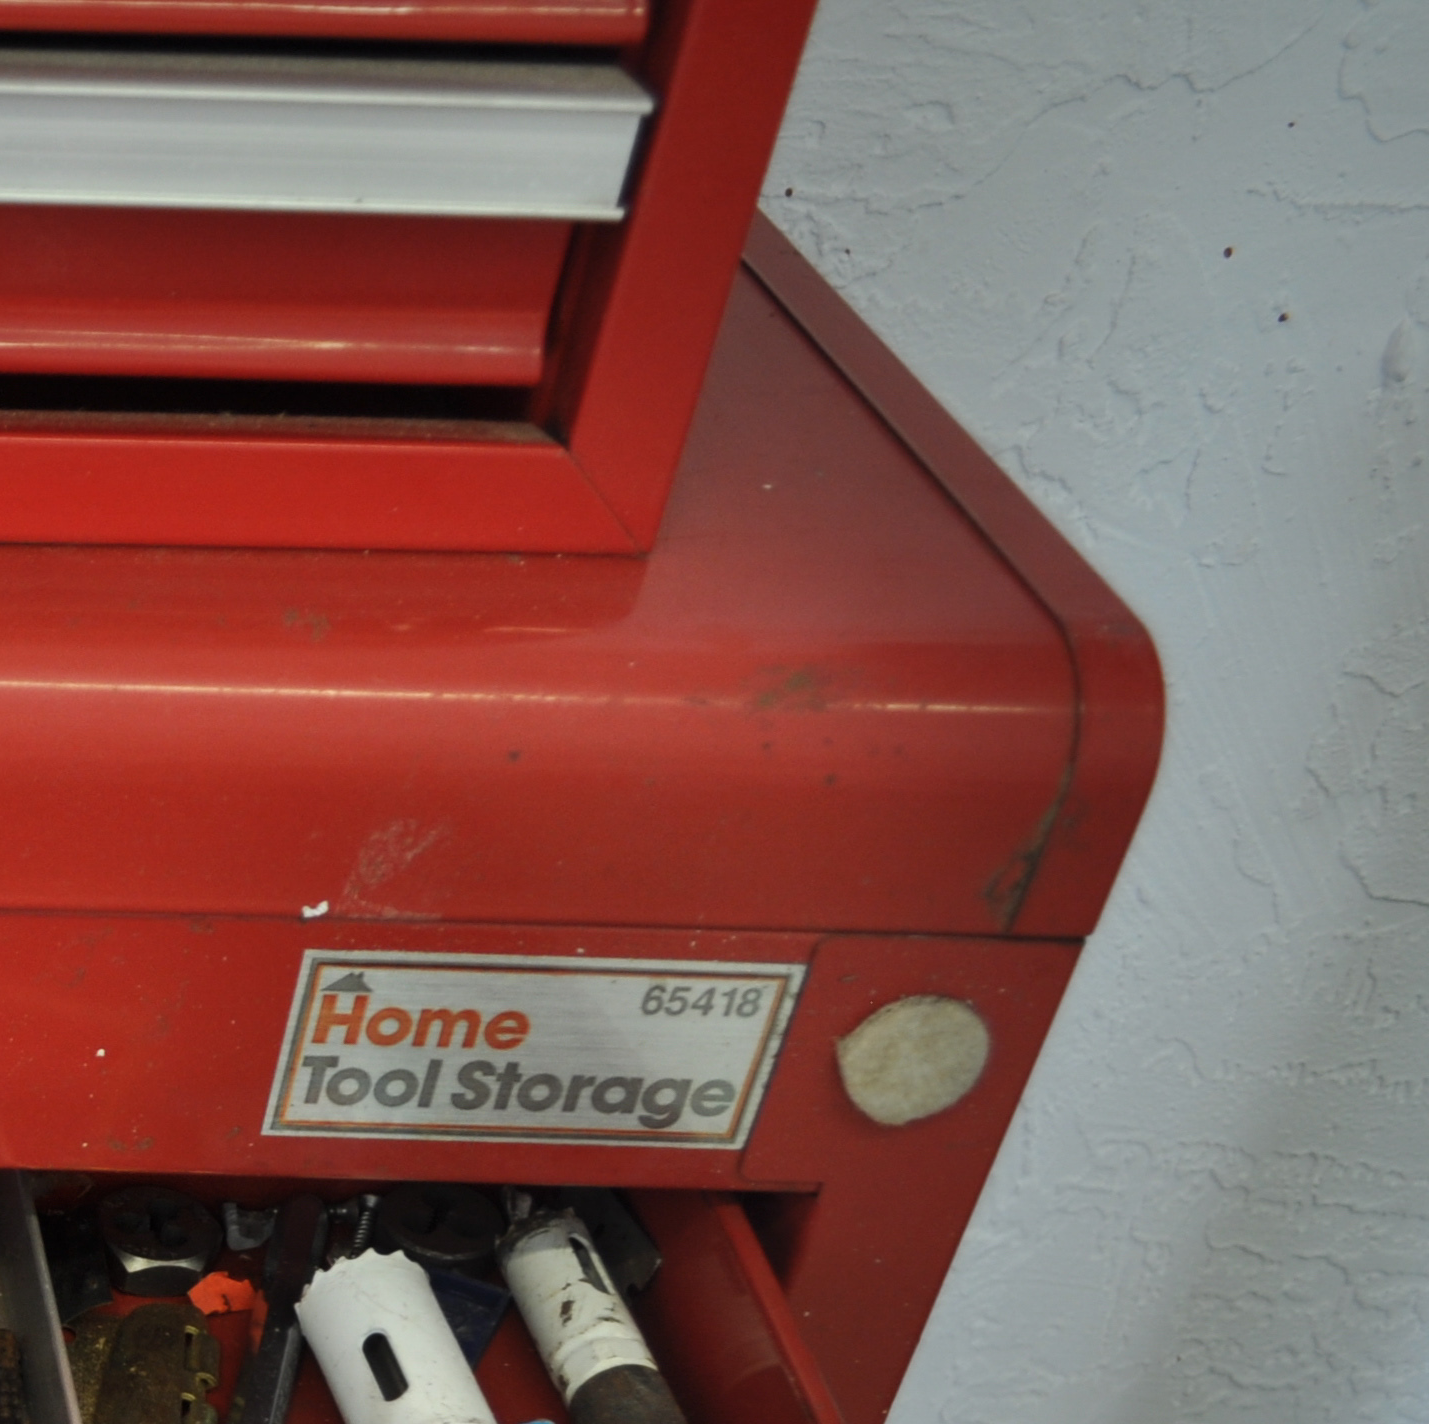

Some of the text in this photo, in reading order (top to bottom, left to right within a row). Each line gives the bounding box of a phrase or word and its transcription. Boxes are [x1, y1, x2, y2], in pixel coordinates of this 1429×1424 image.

[310, 994, 531, 1050] Home
[640, 984, 762, 1018] 65418
[302, 1055, 738, 1130] Tool Storage
